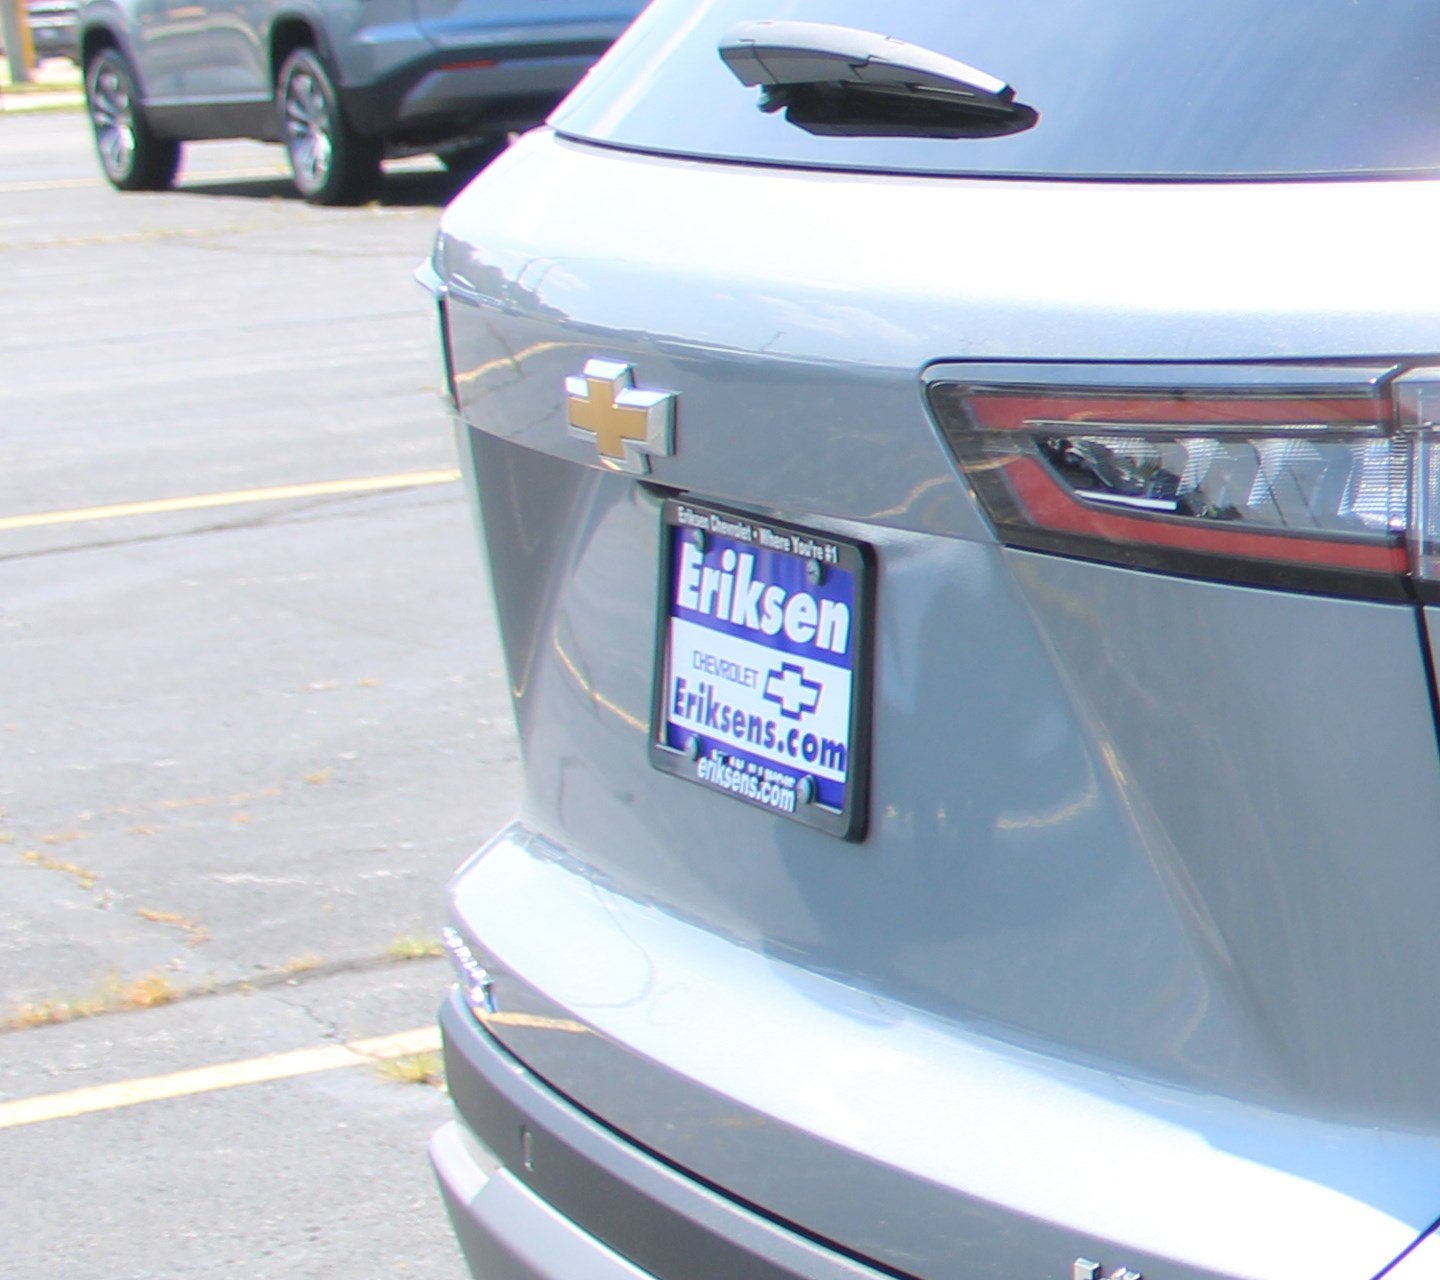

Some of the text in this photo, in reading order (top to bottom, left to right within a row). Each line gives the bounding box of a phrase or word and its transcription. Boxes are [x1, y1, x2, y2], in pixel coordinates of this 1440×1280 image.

[758, 527, 792, 553] Where
[825, 543, 838, 564] #1
[676, 541, 850, 655] Eriksen
[692, 650, 759, 690] CHEVROLET
[672, 676, 846, 773] Eriksens.com
[697, 756, 796, 813] eriksens.com
